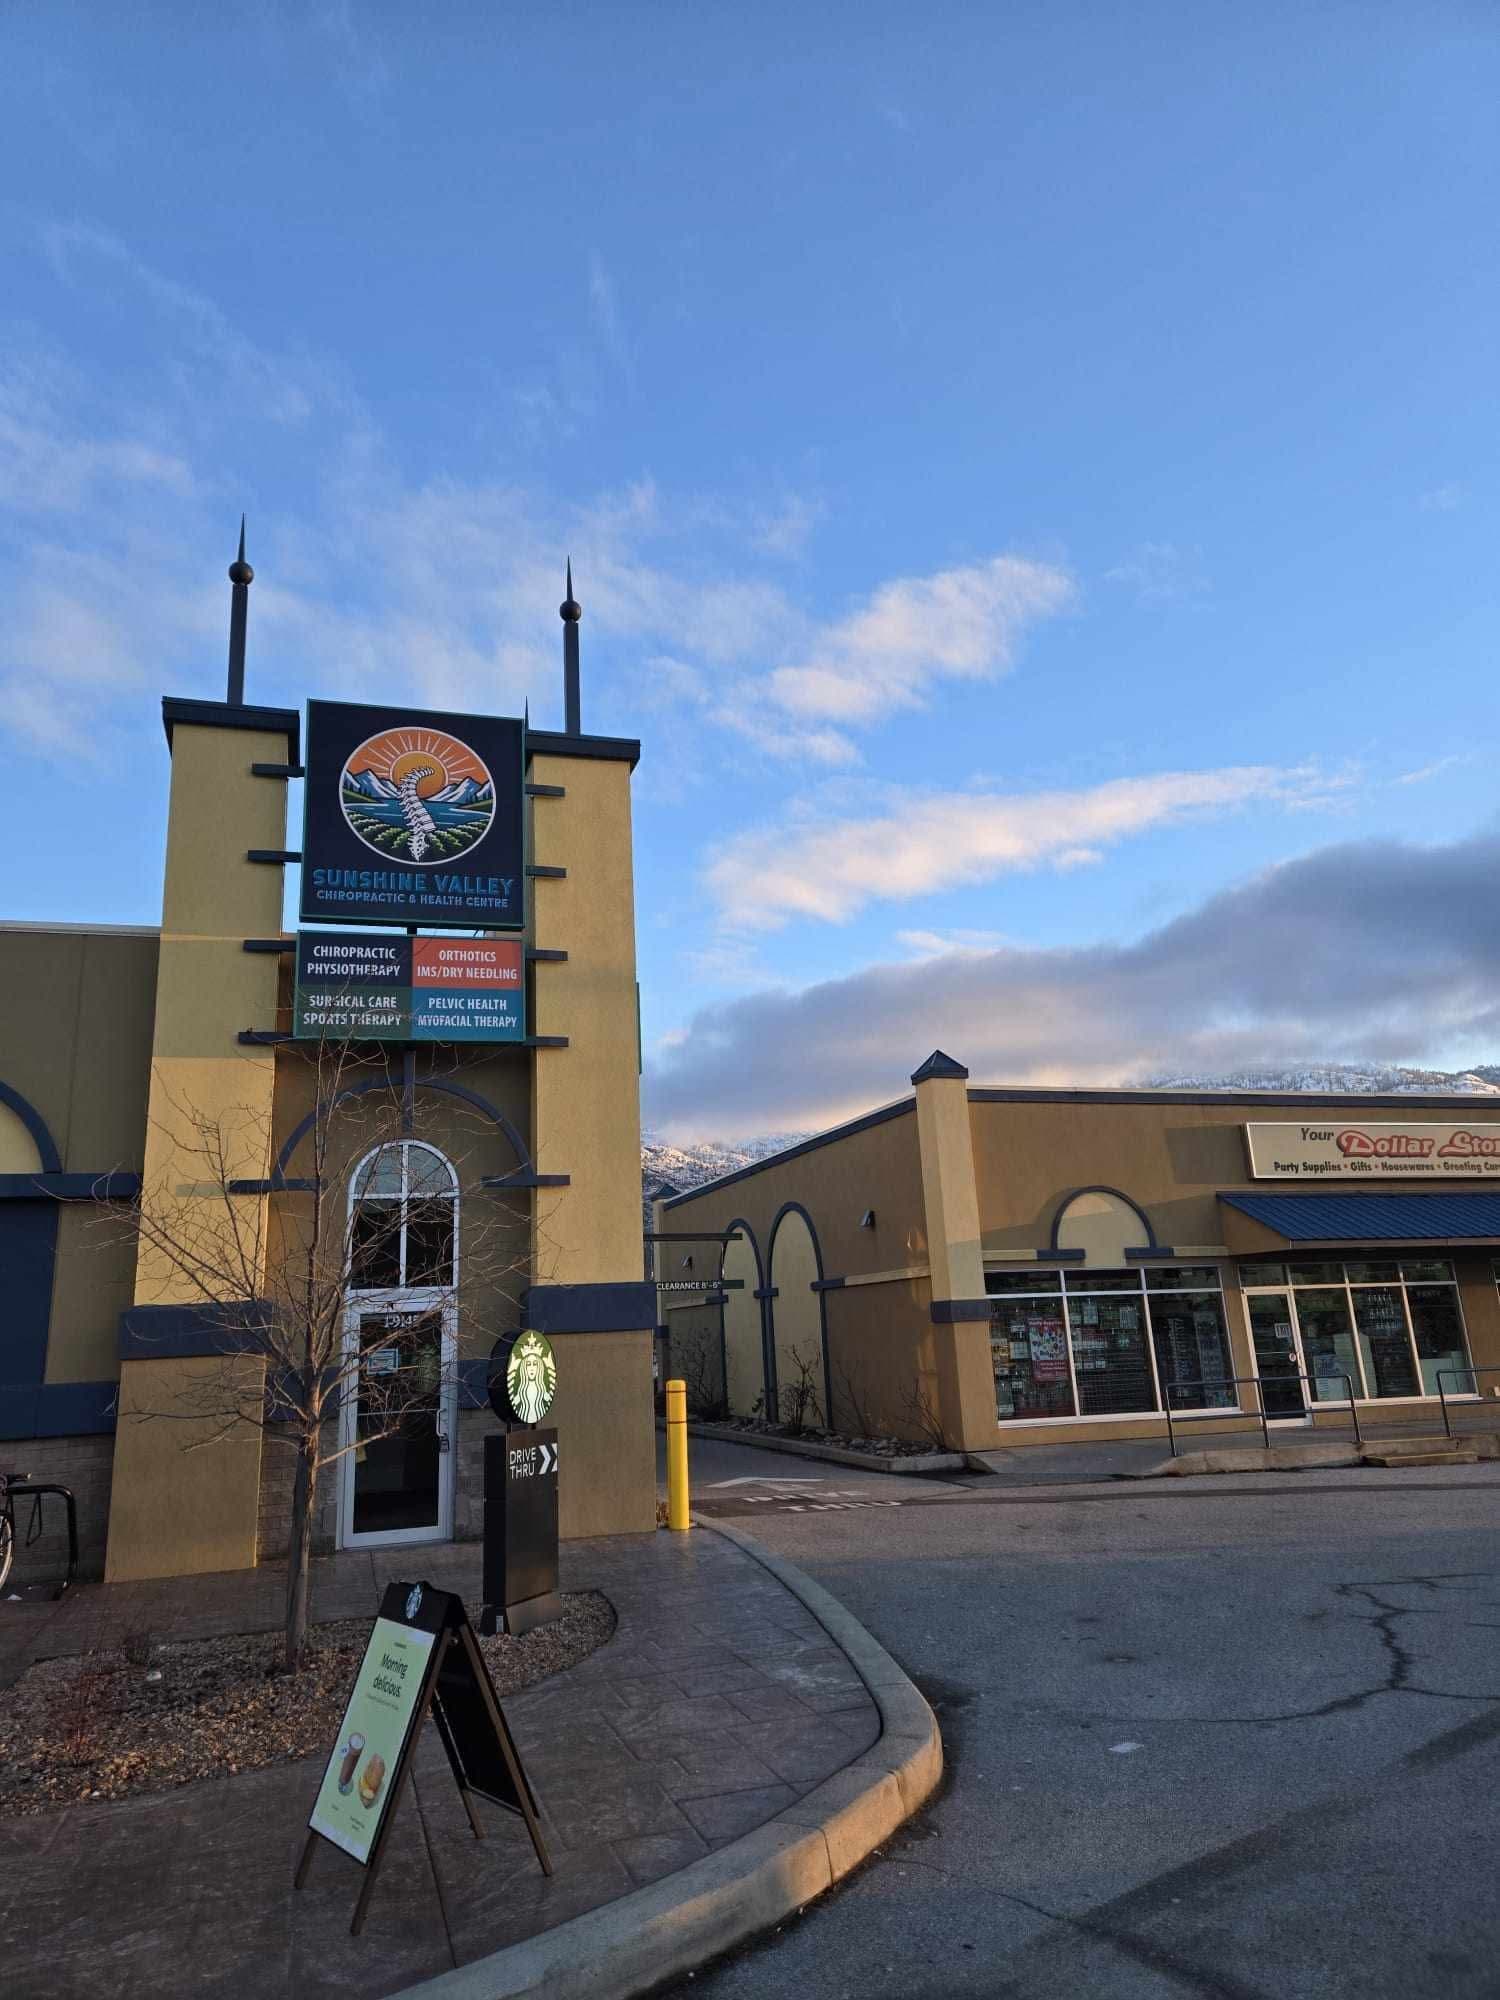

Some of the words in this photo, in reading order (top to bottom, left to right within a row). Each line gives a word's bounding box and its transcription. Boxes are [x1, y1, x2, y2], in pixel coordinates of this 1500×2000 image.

[312, 868, 427, 892] SUNSHINE
[434, 874, 514, 896] VALLEY
[316, 889, 406, 904] CHIROPRACTIC
[408, 894, 417, 904] &
[420, 894, 463, 906] HEALTH
[466, 896, 509, 908] CENTRE
[313, 945, 396, 960] CHIROPRACTIC
[438, 950, 497, 962] ORTHOTICS
[307, 962, 401, 977] PHYSIOTHERAPY
[417, 965, 464, 979] IMS/DRY
[466, 967, 518, 980] NEEDLING
[368, 996, 398, 1008] CARE
[428, 997, 465, 1009] PELVIC
[467, 998, 507, 1011] HEALTH
[303, 1012, 348, 1025] SPORTS
[350, 1013, 402, 1026] THERAPY
[417, 1014, 472, 1027] MYOFACIAL
[474, 1015, 518, 1028] THERAPY
[1300, 1127, 1335, 1141] Your
[1336, 1130, 1435, 1159] Dollar
[1274, 1161, 1299, 1173] Party
[1302, 1161, 1342, 1174] Supplies
[1350, 1161, 1372, 1172] Gifts
[1381, 1161, 1435, 1172] Housewares
[1443, 1161, 1482, 1174] Greeting
[656, 1282, 701, 1291] CLEARANCE
[509, 1447, 536, 1465] DRIVE
[509, 1463, 535, 1479] THRU
[777, 1501, 902, 1512] THRU
[382, 1653, 409, 1680] Morning
